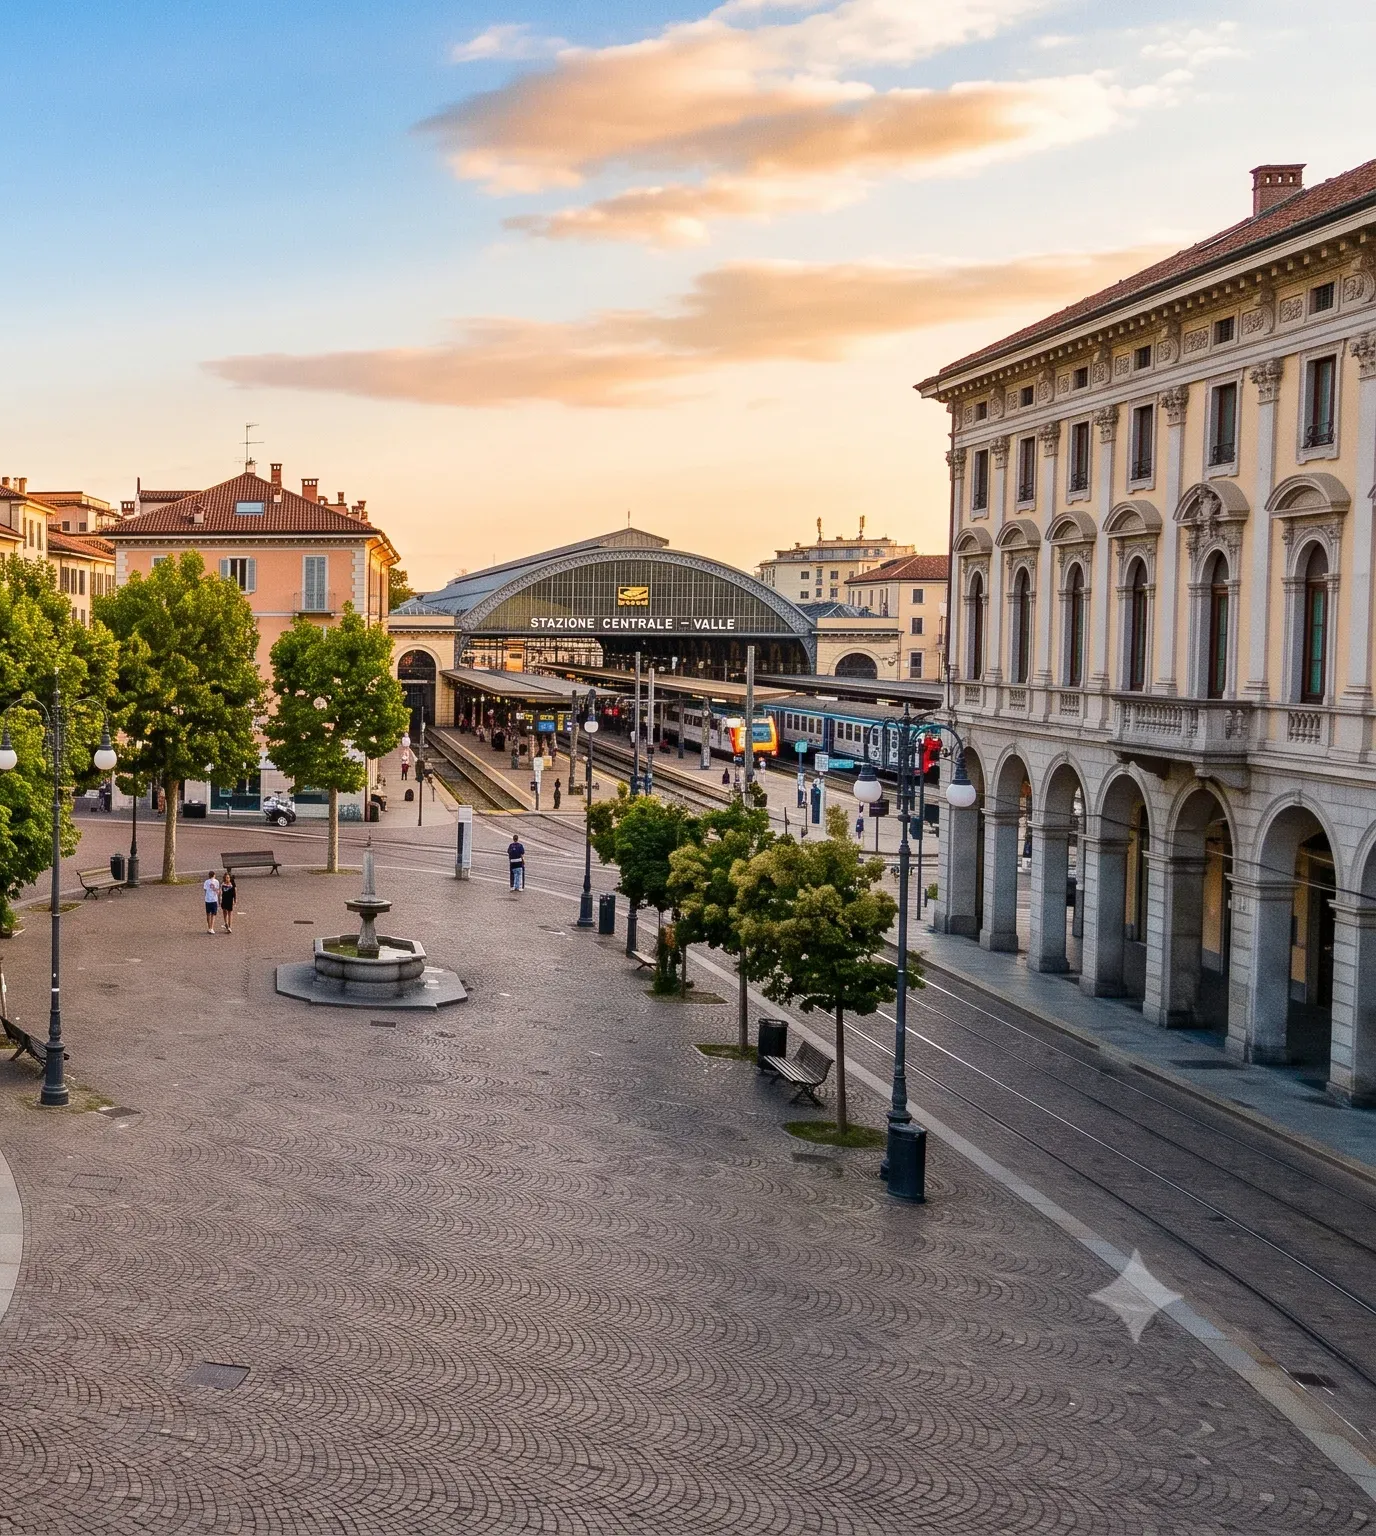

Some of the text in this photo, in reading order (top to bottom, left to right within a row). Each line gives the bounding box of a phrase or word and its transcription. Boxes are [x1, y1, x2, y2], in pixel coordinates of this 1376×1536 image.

[530, 617, 595, 629] STAZIONE
[602, 618, 673, 630] CENTRALE
[693, 618, 735, 630] VALLE
